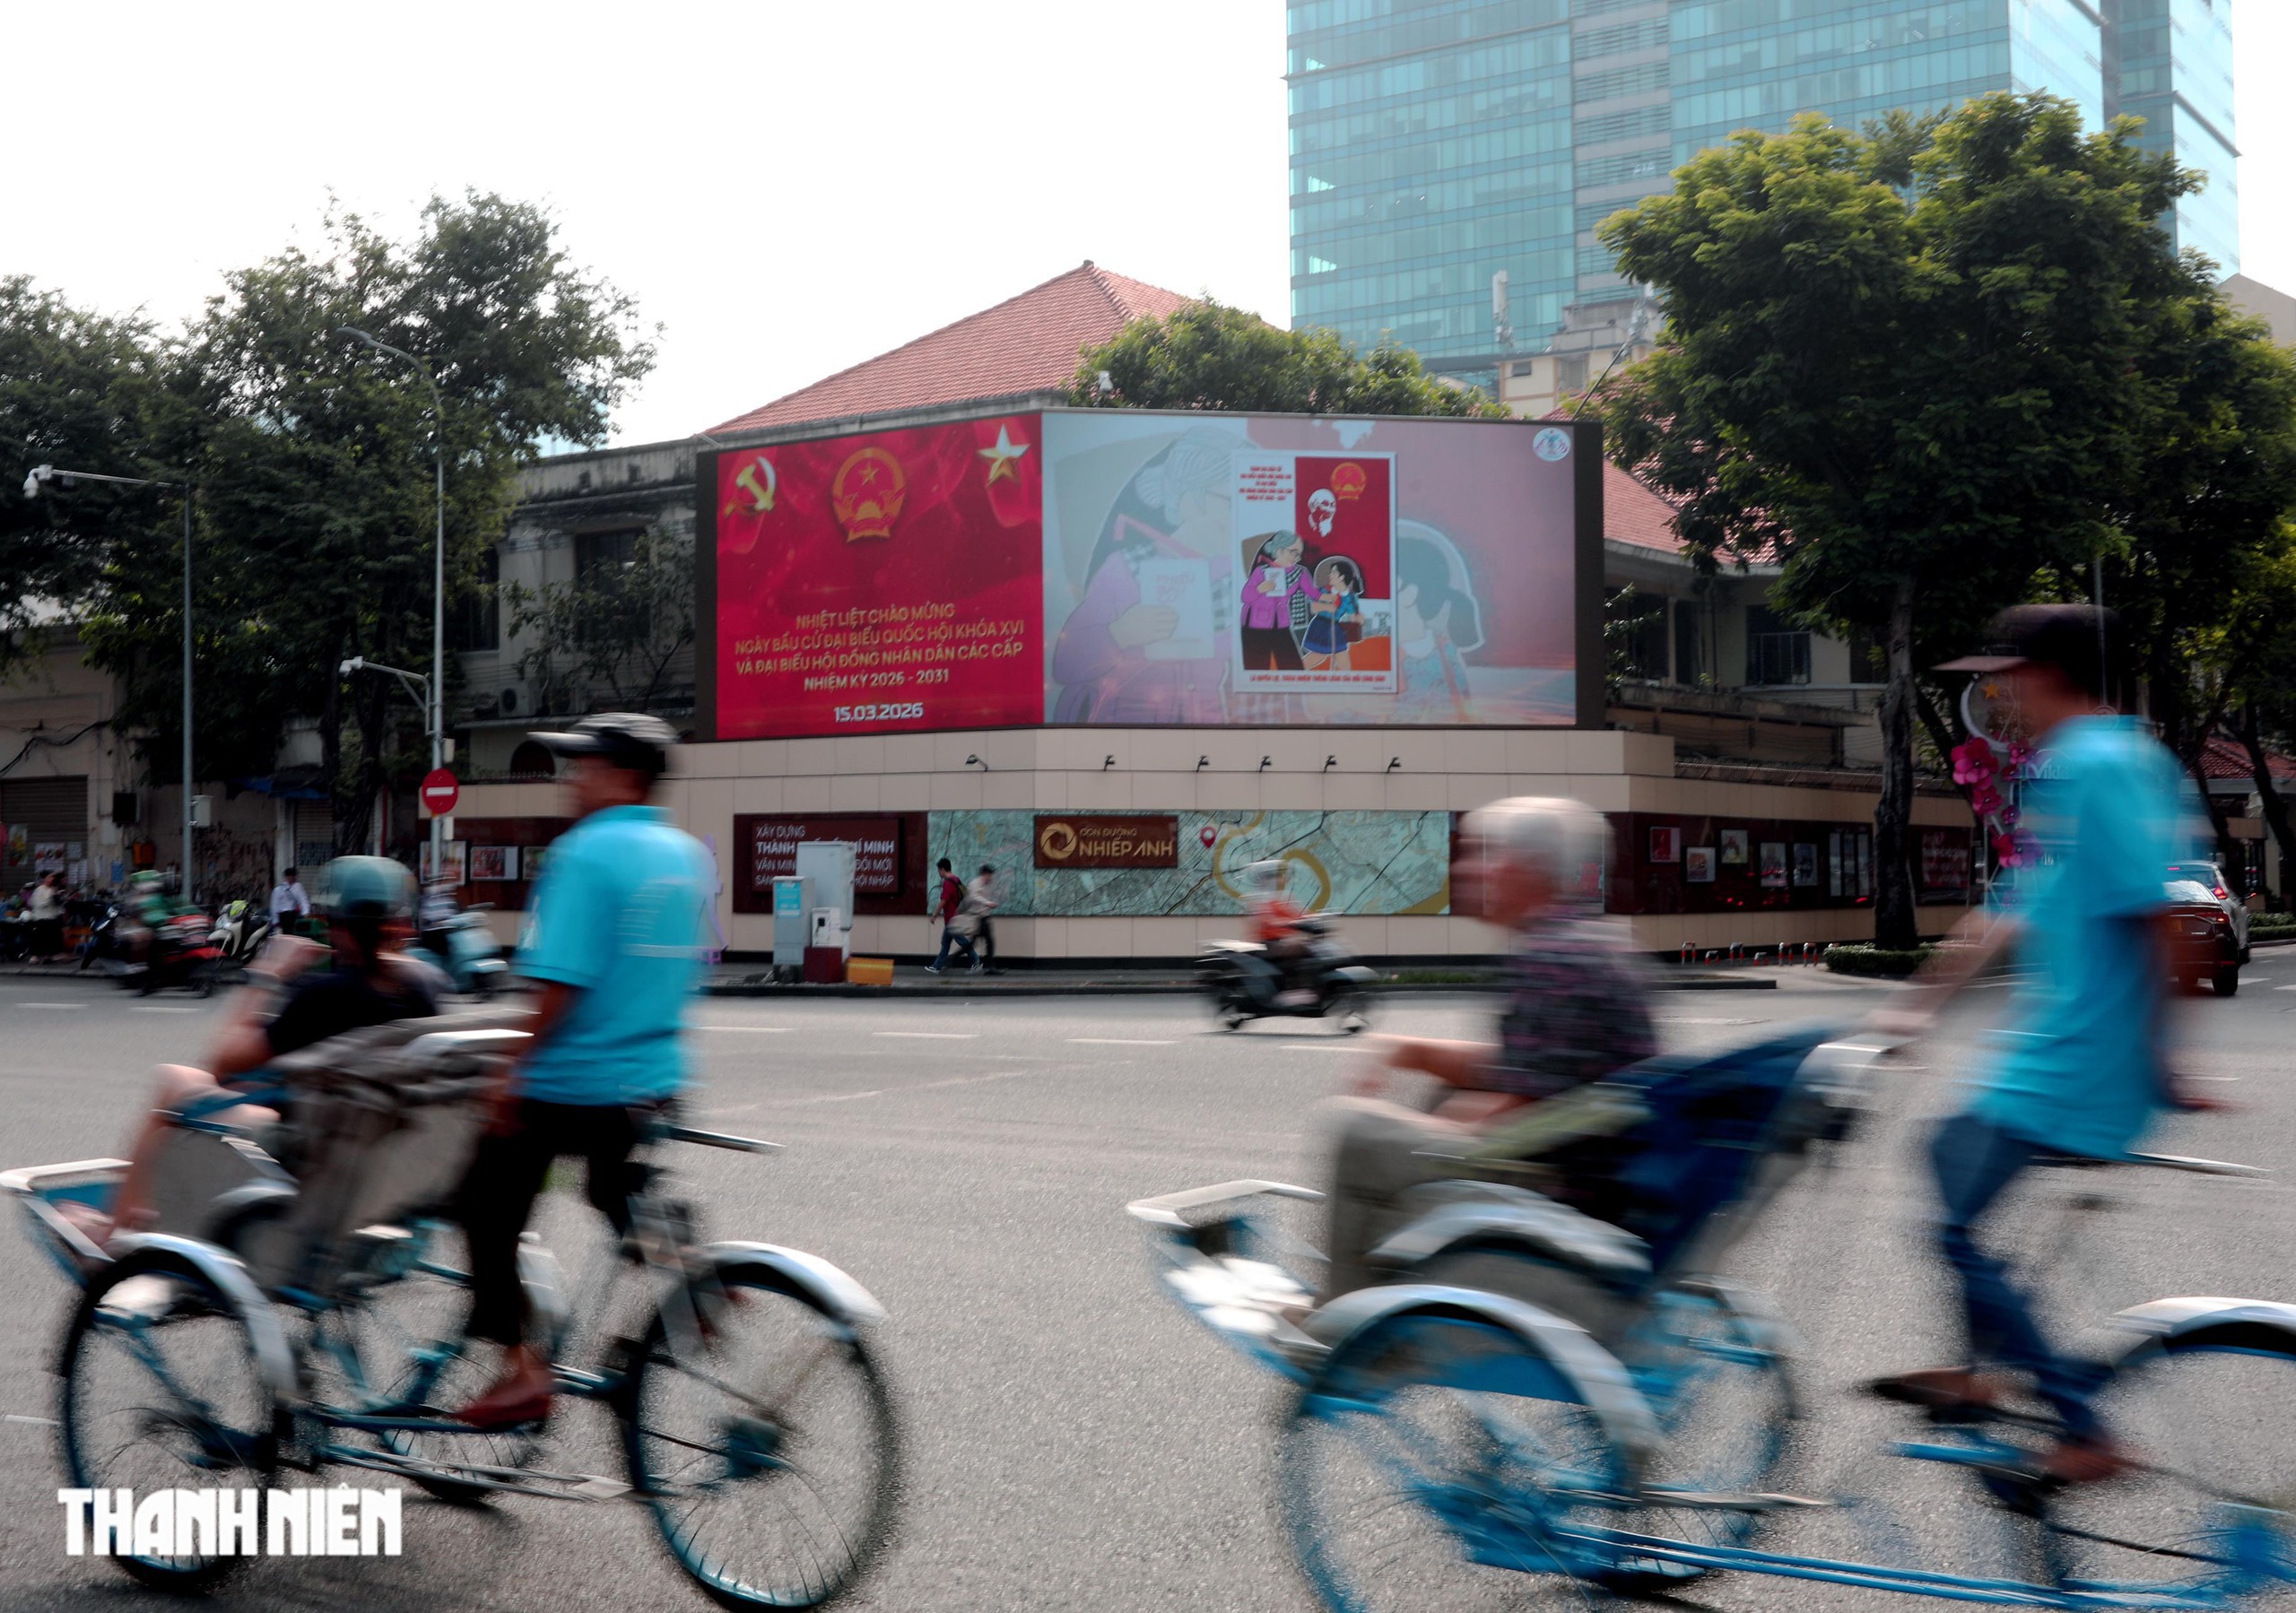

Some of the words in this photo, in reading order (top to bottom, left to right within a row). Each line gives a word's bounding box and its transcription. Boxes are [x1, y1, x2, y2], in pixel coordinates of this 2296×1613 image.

[796, 610, 837, 630] NHIỆT
[839, 607, 866, 628] LIỆT
[868, 603, 909, 623] CHÀO
[911, 601, 955, 620] MỪNG
[735, 635, 770, 655] NGÀY
[772, 631, 799, 652] BẦU
[802, 629, 822, 649] CỬ
[823, 633, 847, 651] ĐẠI
[848, 625, 880, 646] BIỂU
[883, 622, 925, 644] QUỐC
[927, 621, 952, 643] HỘI
[956, 618, 997, 638] KHÓA
[999, 619, 1024, 636] XVI
[736, 656, 753, 674] VÀ
[755, 659, 778, 676] ĐẠI
[779, 652, 810, 672] BIỂU
[813, 652, 837, 672] HỘI
[839, 647, 880, 668] ĐỒNG
[883, 646, 922, 665] NHÂN
[926, 643, 955, 662] DÂN
[958, 640, 988, 660] CÁC
[991, 637, 1023, 658] CẤP
[804, 672, 848, 693] NHIỆM
[850, 670, 868, 689] KỲ
[870, 672, 905, 688] 2026
[916, 668, 950, 684] 2031
[834, 702, 924, 723] 15.03.2026
[756, 824, 775, 837] XÂY
[776, 825, 806, 838] DỰNG
[755, 838, 796, 854] THÀNH
[864, 840, 895, 854] MINH
[1079, 837, 1133, 857] NHIẾP
[777, 859, 796, 872] MIN
[873, 856, 892, 872] MỚI
[869, 873, 895, 888] NHẬP
